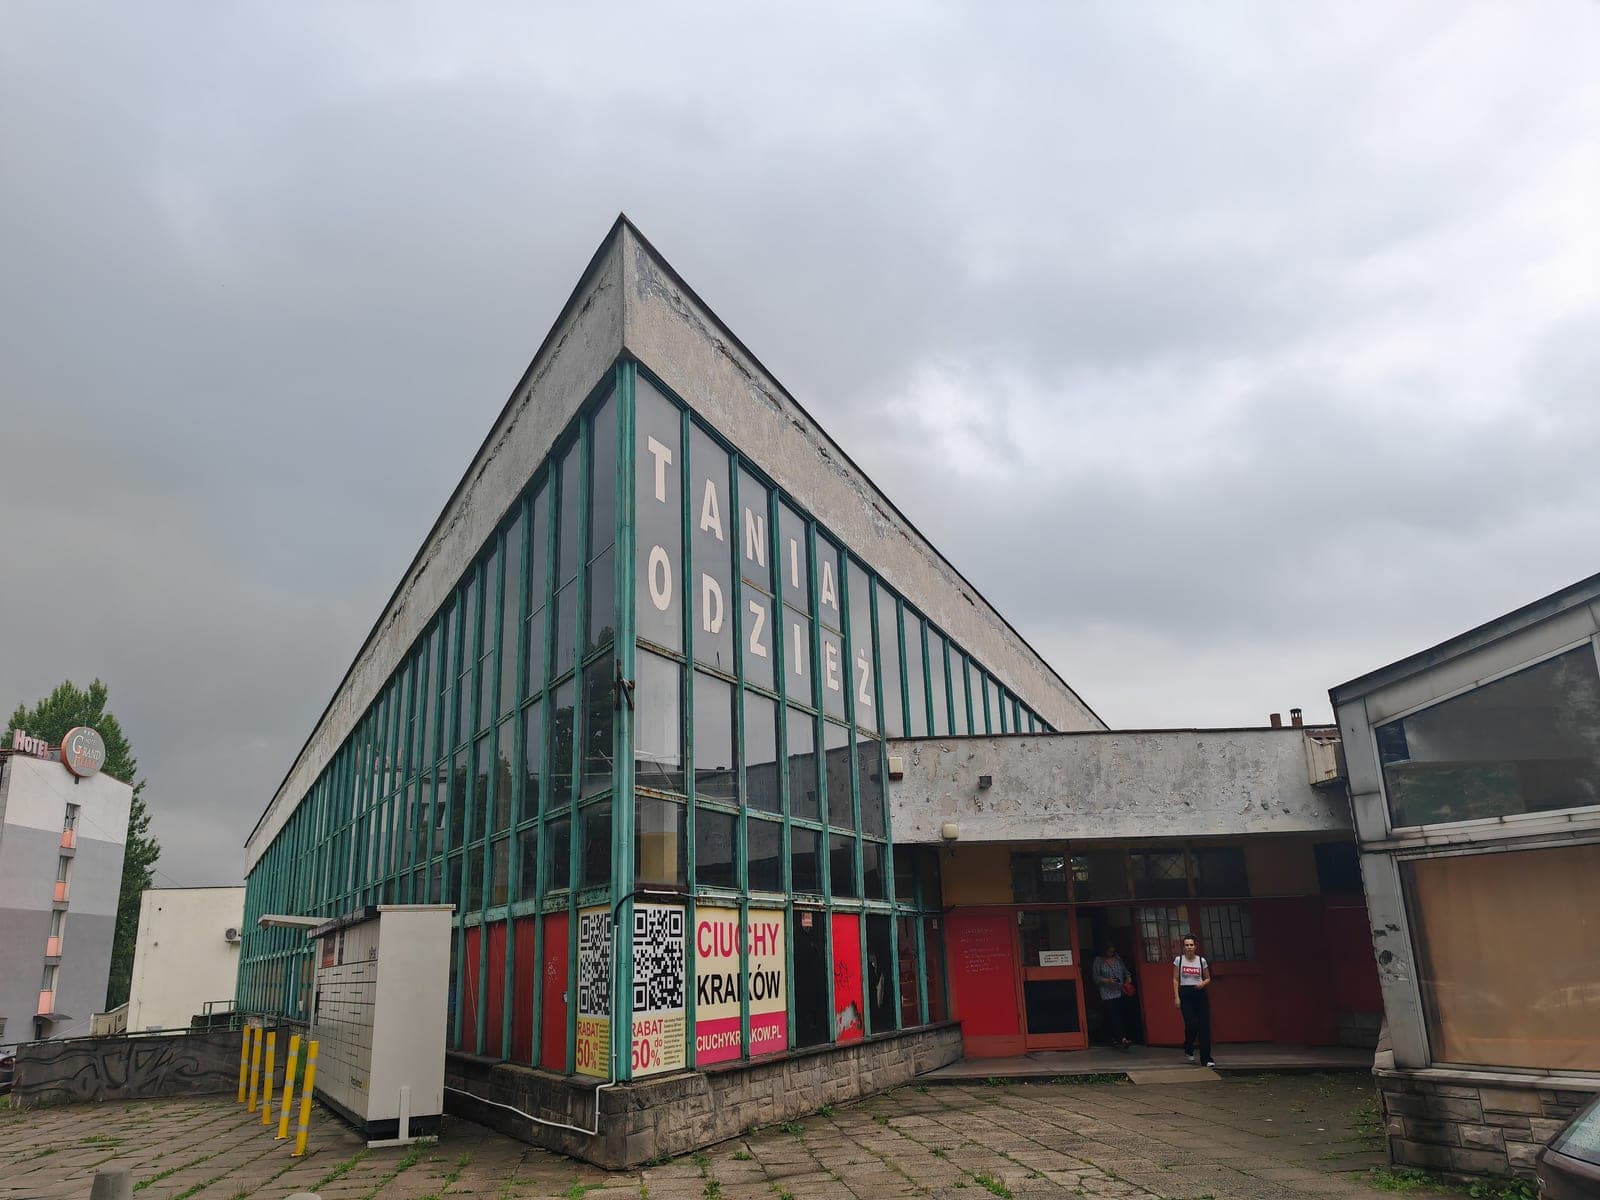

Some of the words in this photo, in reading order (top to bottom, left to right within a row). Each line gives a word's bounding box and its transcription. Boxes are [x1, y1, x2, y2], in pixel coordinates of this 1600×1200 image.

[648, 435, 838, 611] TANIA
[648, 544, 872, 706] ODZIEŻ
[577, 1021, 600, 1038] RABAT
[654, 1037, 663, 1047] do
